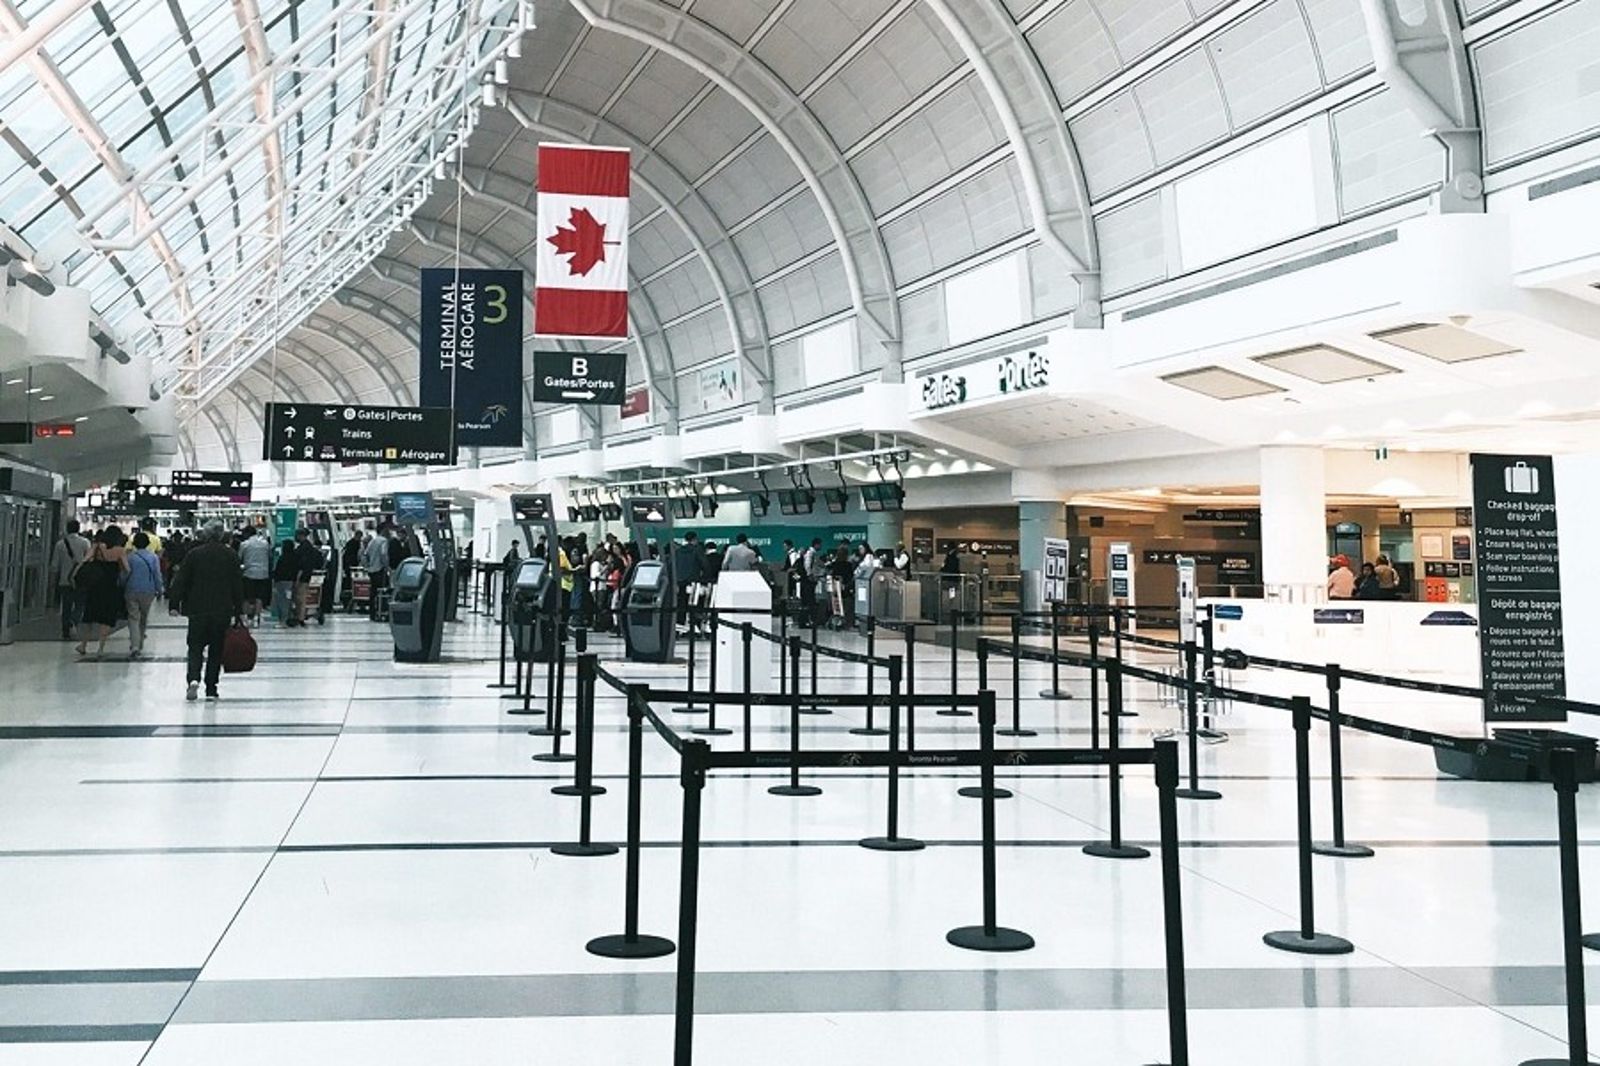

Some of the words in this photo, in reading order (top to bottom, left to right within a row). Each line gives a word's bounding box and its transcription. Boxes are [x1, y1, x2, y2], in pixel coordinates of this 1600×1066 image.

[483, 285, 508, 323] 3
[441, 282, 456, 370] TERMINAL
[457, 283, 475, 370] AÉROGARE
[572, 357, 588, 376] B
[342, 428, 372, 439] Trains
[341, 447, 383, 458] Terminal
[401, 448, 445, 461] Aérogare
[1487, 500, 1523, 511] Checked
[1524, 502, 1555, 513] baggag
[1507, 513, 1541, 522] drop-off
[1518, 599, 1529, 608] de
